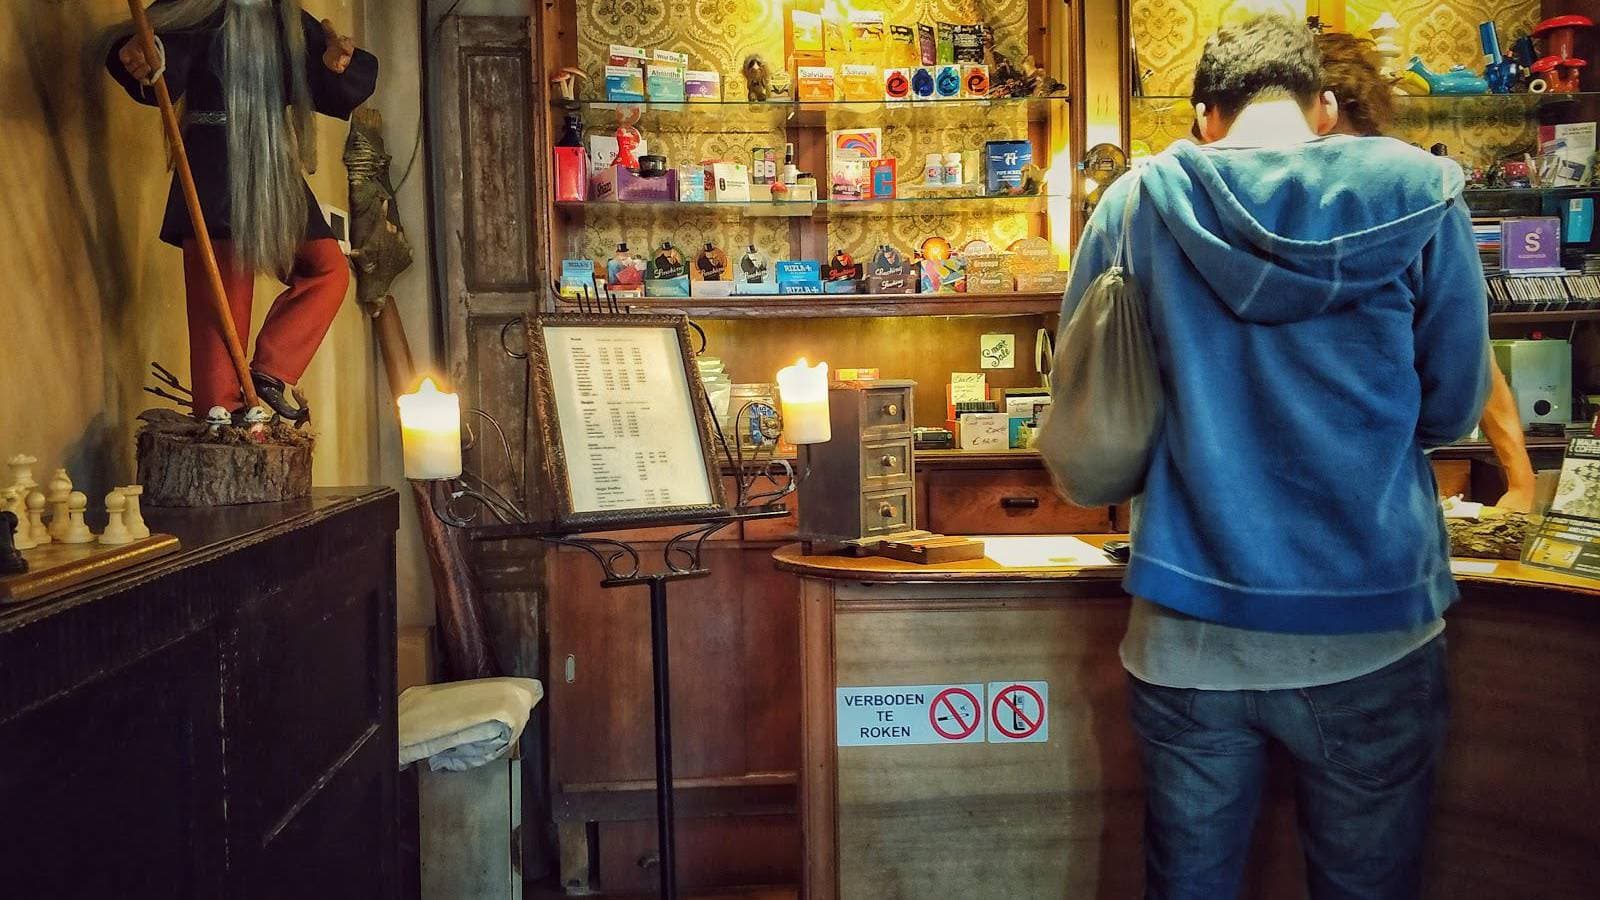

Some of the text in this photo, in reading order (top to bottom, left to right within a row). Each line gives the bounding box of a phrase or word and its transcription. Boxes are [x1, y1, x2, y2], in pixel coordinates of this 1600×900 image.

[844, 694, 924, 707] VERBODEN
[876, 711, 894, 722] TE
[860, 726, 911, 738] ROKEN
